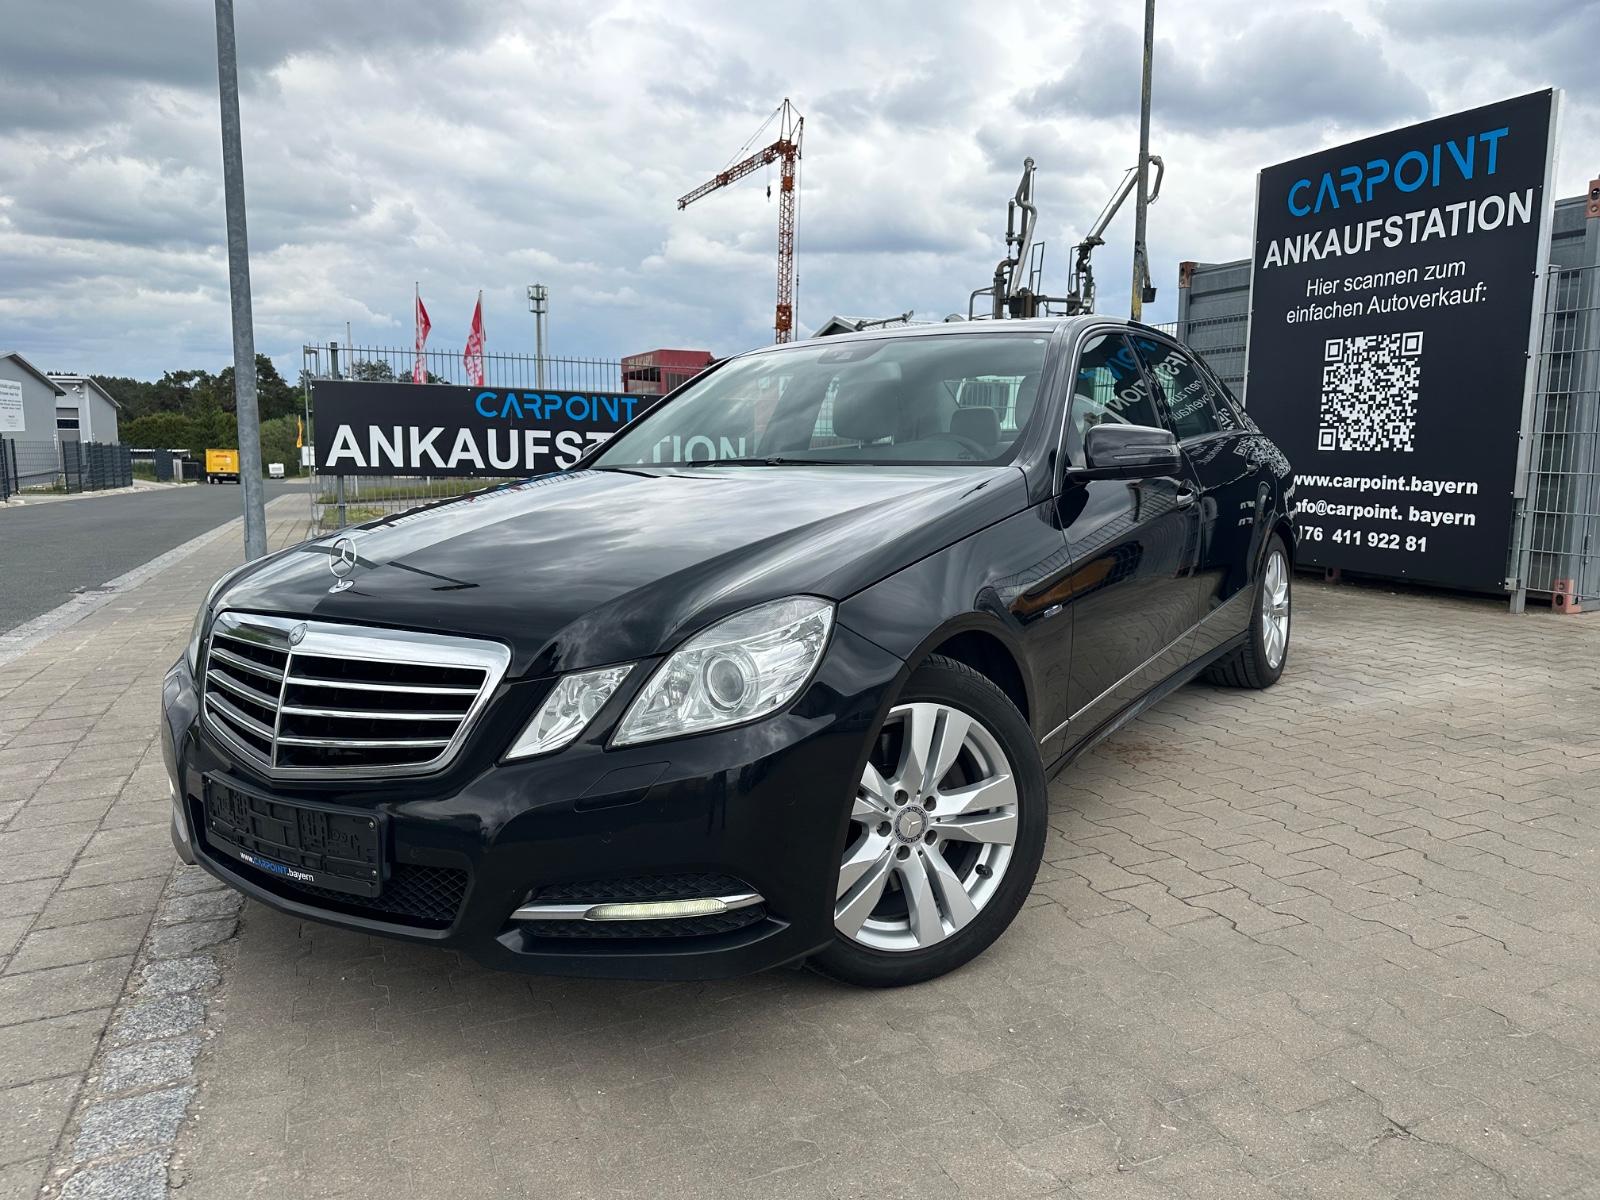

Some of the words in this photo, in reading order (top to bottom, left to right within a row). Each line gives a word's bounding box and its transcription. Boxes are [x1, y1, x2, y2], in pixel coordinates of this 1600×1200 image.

[1288, 128, 1508, 216] CARPOINT
[1263, 189, 1533, 269] ANKAUFSTATION
[1306, 278, 1340, 297] Hier
[1343, 267, 1418, 292] scannen
[1423, 260, 1466, 281] zum
[1286, 302, 1364, 323] einfachen
[1367, 282, 1487, 314] Autoverkauf:
[476, 392, 639, 424] CARPOINT
[1409, 506, 1476, 527] bayern
[1332, 529, 1362, 546] 411
[1368, 532, 1401, 550] 922
[1406, 536, 1427, 553] 81
